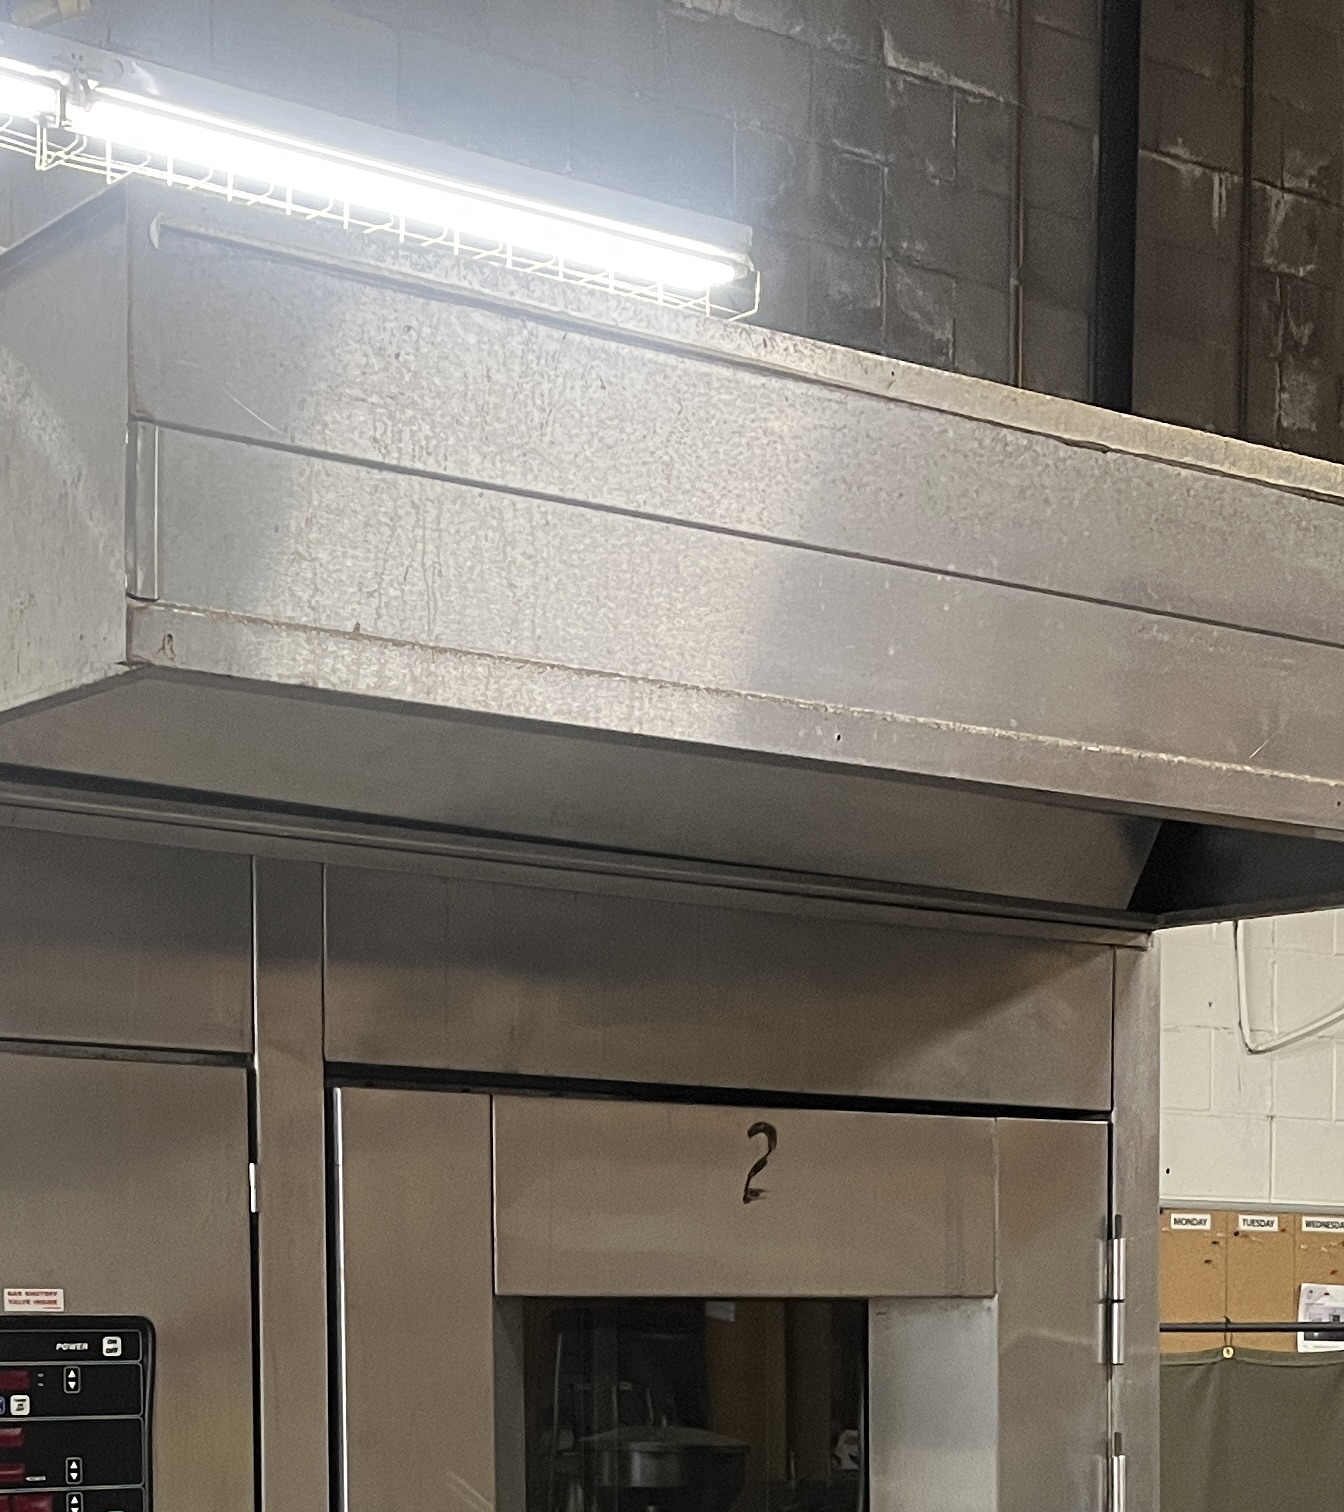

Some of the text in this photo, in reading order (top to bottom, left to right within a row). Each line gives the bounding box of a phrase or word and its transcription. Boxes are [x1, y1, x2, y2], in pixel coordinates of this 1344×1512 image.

[743, 1121, 777, 1204] 2
[1173, 1217, 1208, 1227] MONDAY
[1242, 1218, 1275, 1228] TUESDAY
[56, 1343, 88, 1351] POWER
